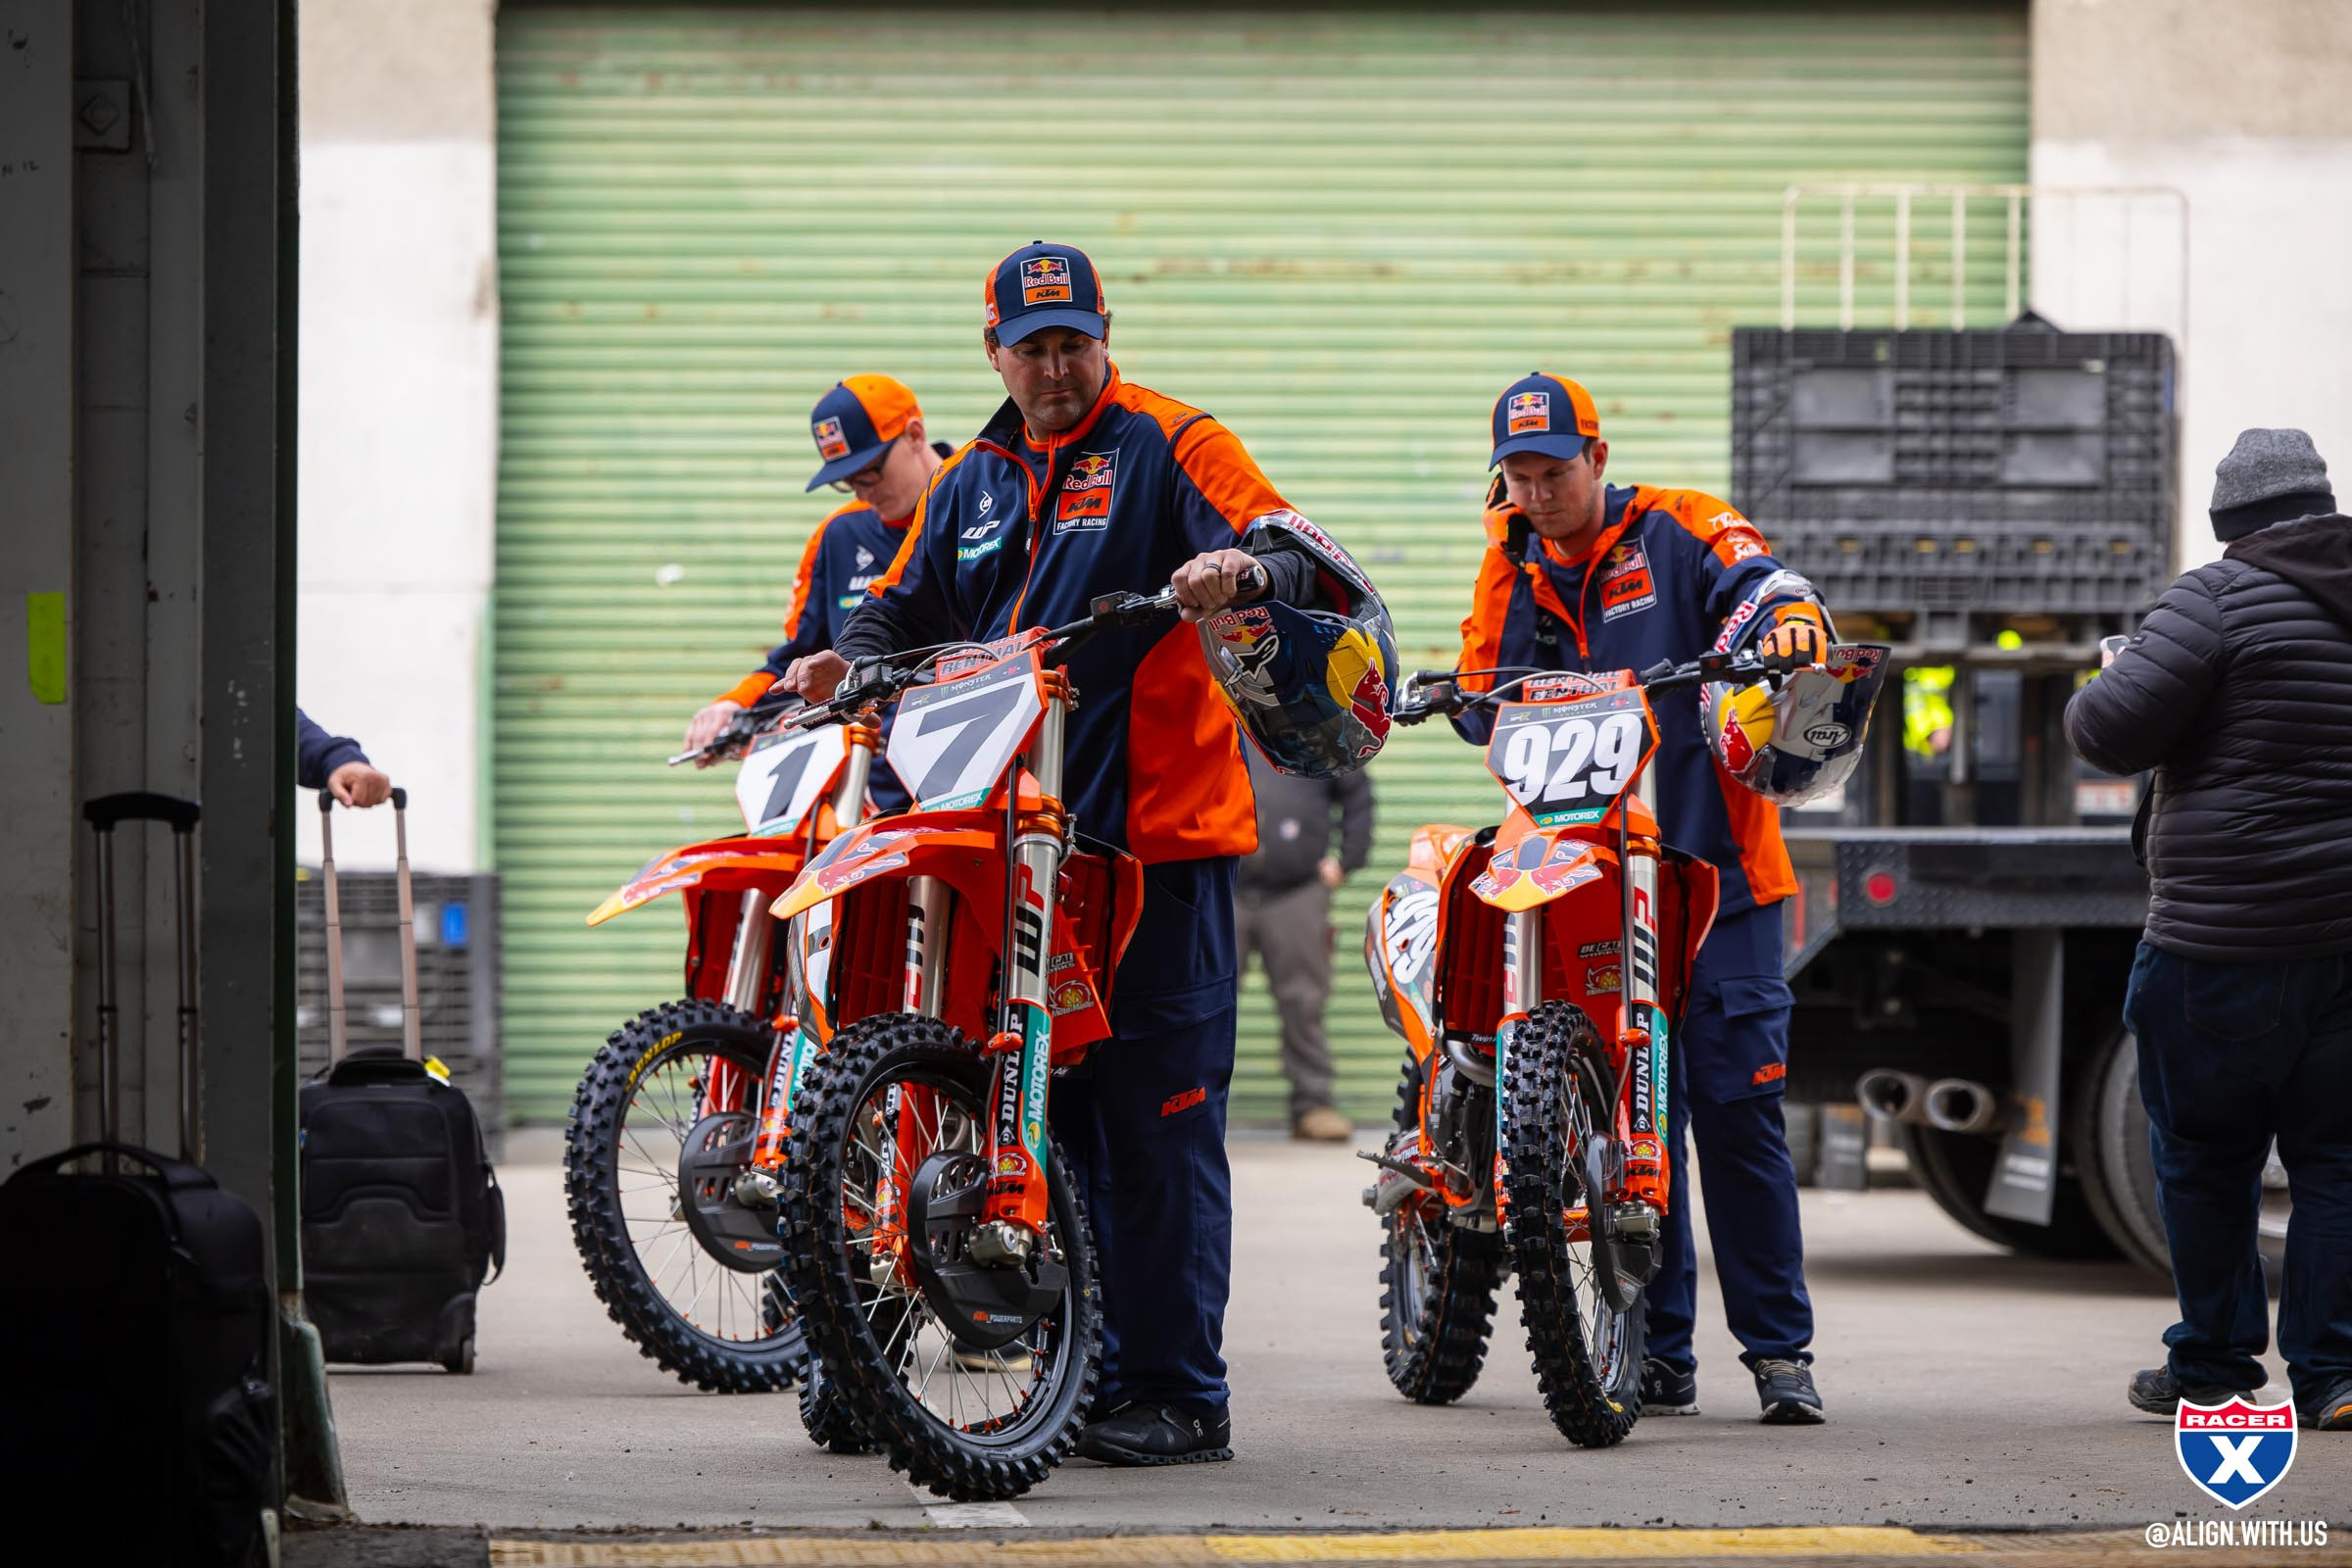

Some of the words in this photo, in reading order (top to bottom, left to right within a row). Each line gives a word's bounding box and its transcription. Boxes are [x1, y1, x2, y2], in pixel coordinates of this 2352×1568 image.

[1023, 273, 1046, 287] Red
[1047, 272, 1068, 284] Bull
[1036, 288, 1060, 299] KTM
[1062, 471, 1090, 490] Red
[1088, 469, 1113, 488] Bull
[1066, 495, 1102, 514] KTM
[960, 519, 1001, 539] WP
[1056, 518, 1081, 531] FACRY
[1082, 517, 1107, 528] RACING
[1622, 552, 1647, 573] Bull
[1608, 579, 1643, 600] KTM
[1235, 607, 1271, 625] Red
[1605, 602, 1631, 618] FACTORY
[1630, 594, 1655, 610] RACING
[1206, 612, 1240, 633] Bull
[1715, 600, 1759, 654] Red
[1856, 649, 1883, 663] Red
[951, 673, 993, 693] MONSTER
[1553, 702, 1598, 714] MONSTER
[916, 681, 1026, 803] 7
[1810, 730, 1846, 746] Arai
[1503, 712, 1643, 808] 929
[759, 740, 819, 825] 1
[941, 792, 983, 811] MOTOREX
[1554, 809, 1599, 823] MOTOREX
[1013, 862, 1045, 978] WP
[1634, 886, 1658, 996] WP
[1051, 952, 1074, 967] CAL
[1471, 1033, 1493, 1045] Twin
[628, 1030, 684, 1087] DUNLOP
[1001, 1012, 1025, 1124] DUNLP
[1636, 1012, 1650, 1114] DUNLP
[1028, 1029, 1052, 1122] MOTOREX
[1657, 1030, 1669, 1115] MOTOREX
[1751, 1062, 1787, 1086] KTM
[1161, 1086, 1205, 1117] KTM
[987, 1180, 1026, 1196] KTM
